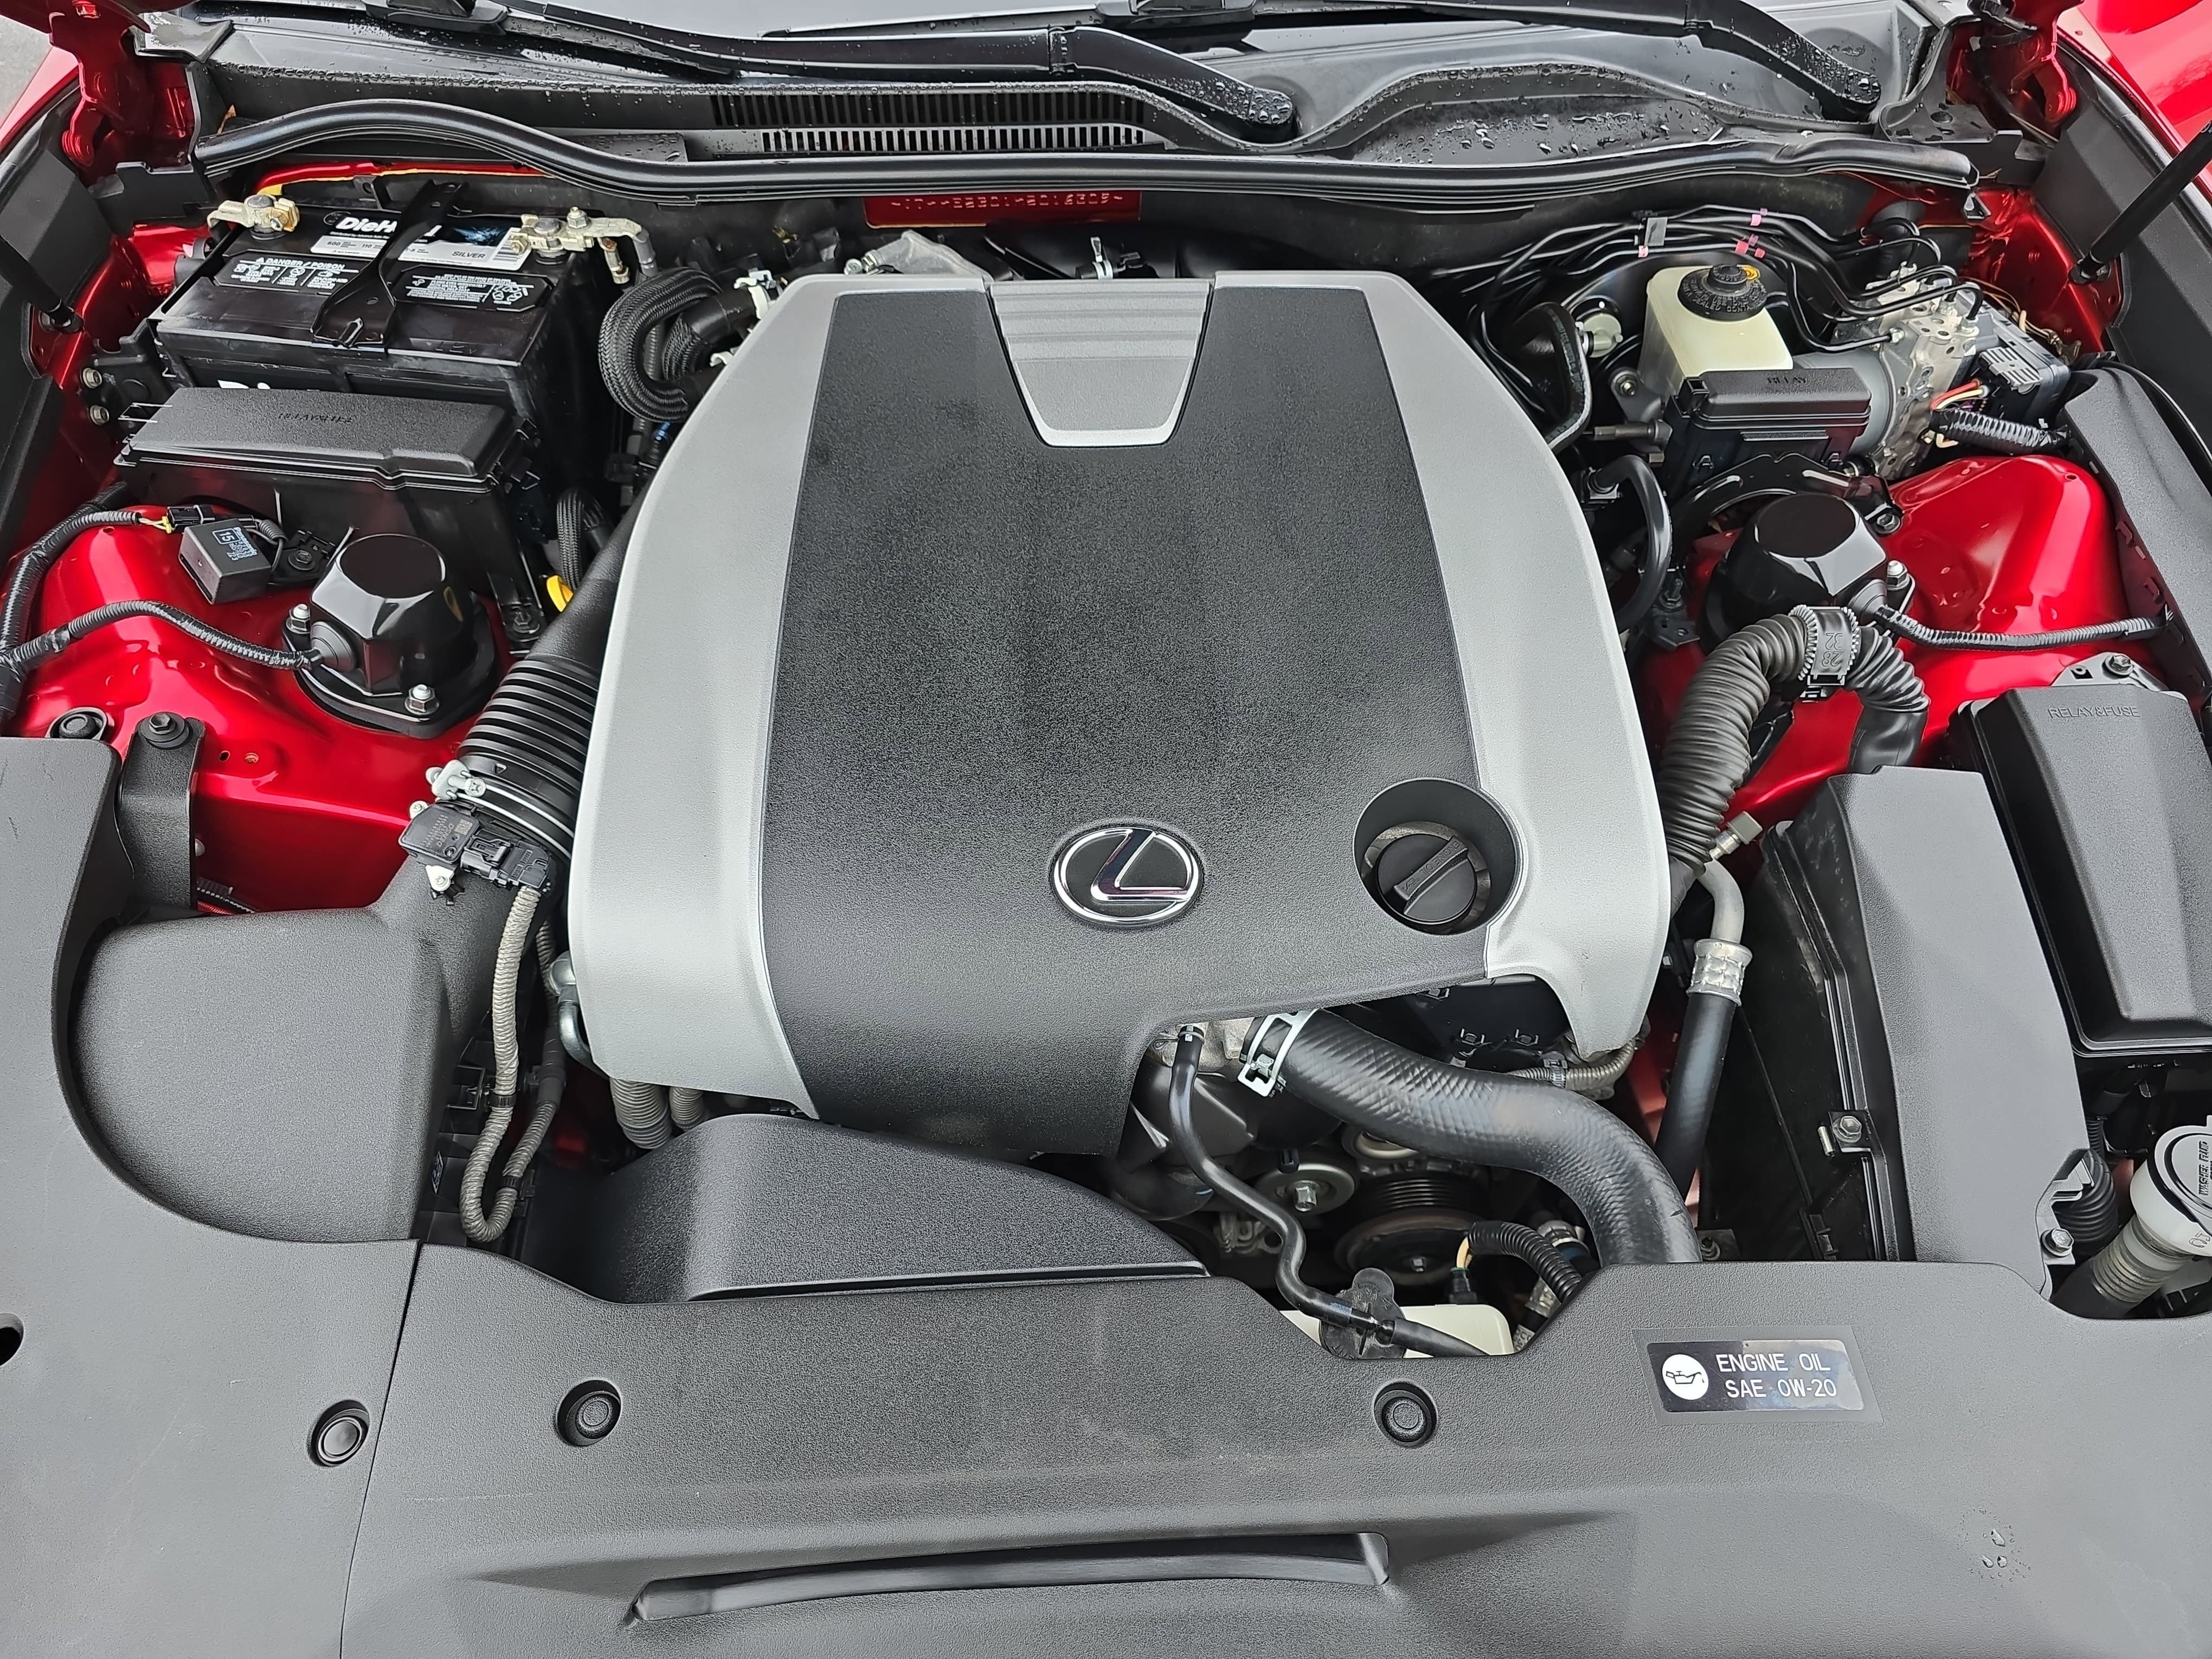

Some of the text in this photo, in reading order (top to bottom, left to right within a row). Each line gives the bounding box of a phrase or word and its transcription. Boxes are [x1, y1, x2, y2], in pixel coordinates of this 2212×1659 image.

[265, 257, 304, 267] DANGER
[452, 250, 486, 259] SILVER
[1693, 295, 1721, 311] SEALED
[219, 531, 235, 542] 15
[233, 526, 258, 556] Panasonic
[2047, 706, 2141, 718] RELAY&FUSE
[436, 823, 455, 848] DENSO
[1419, 840, 1461, 876] ENGINE OIL
[2198, 1140, 2210, 1197] WASHER FLUID
[1715, 1353, 1831, 1373] ENGINE OIL
[1725, 1378, 1837, 1399] SAE 0W-20
